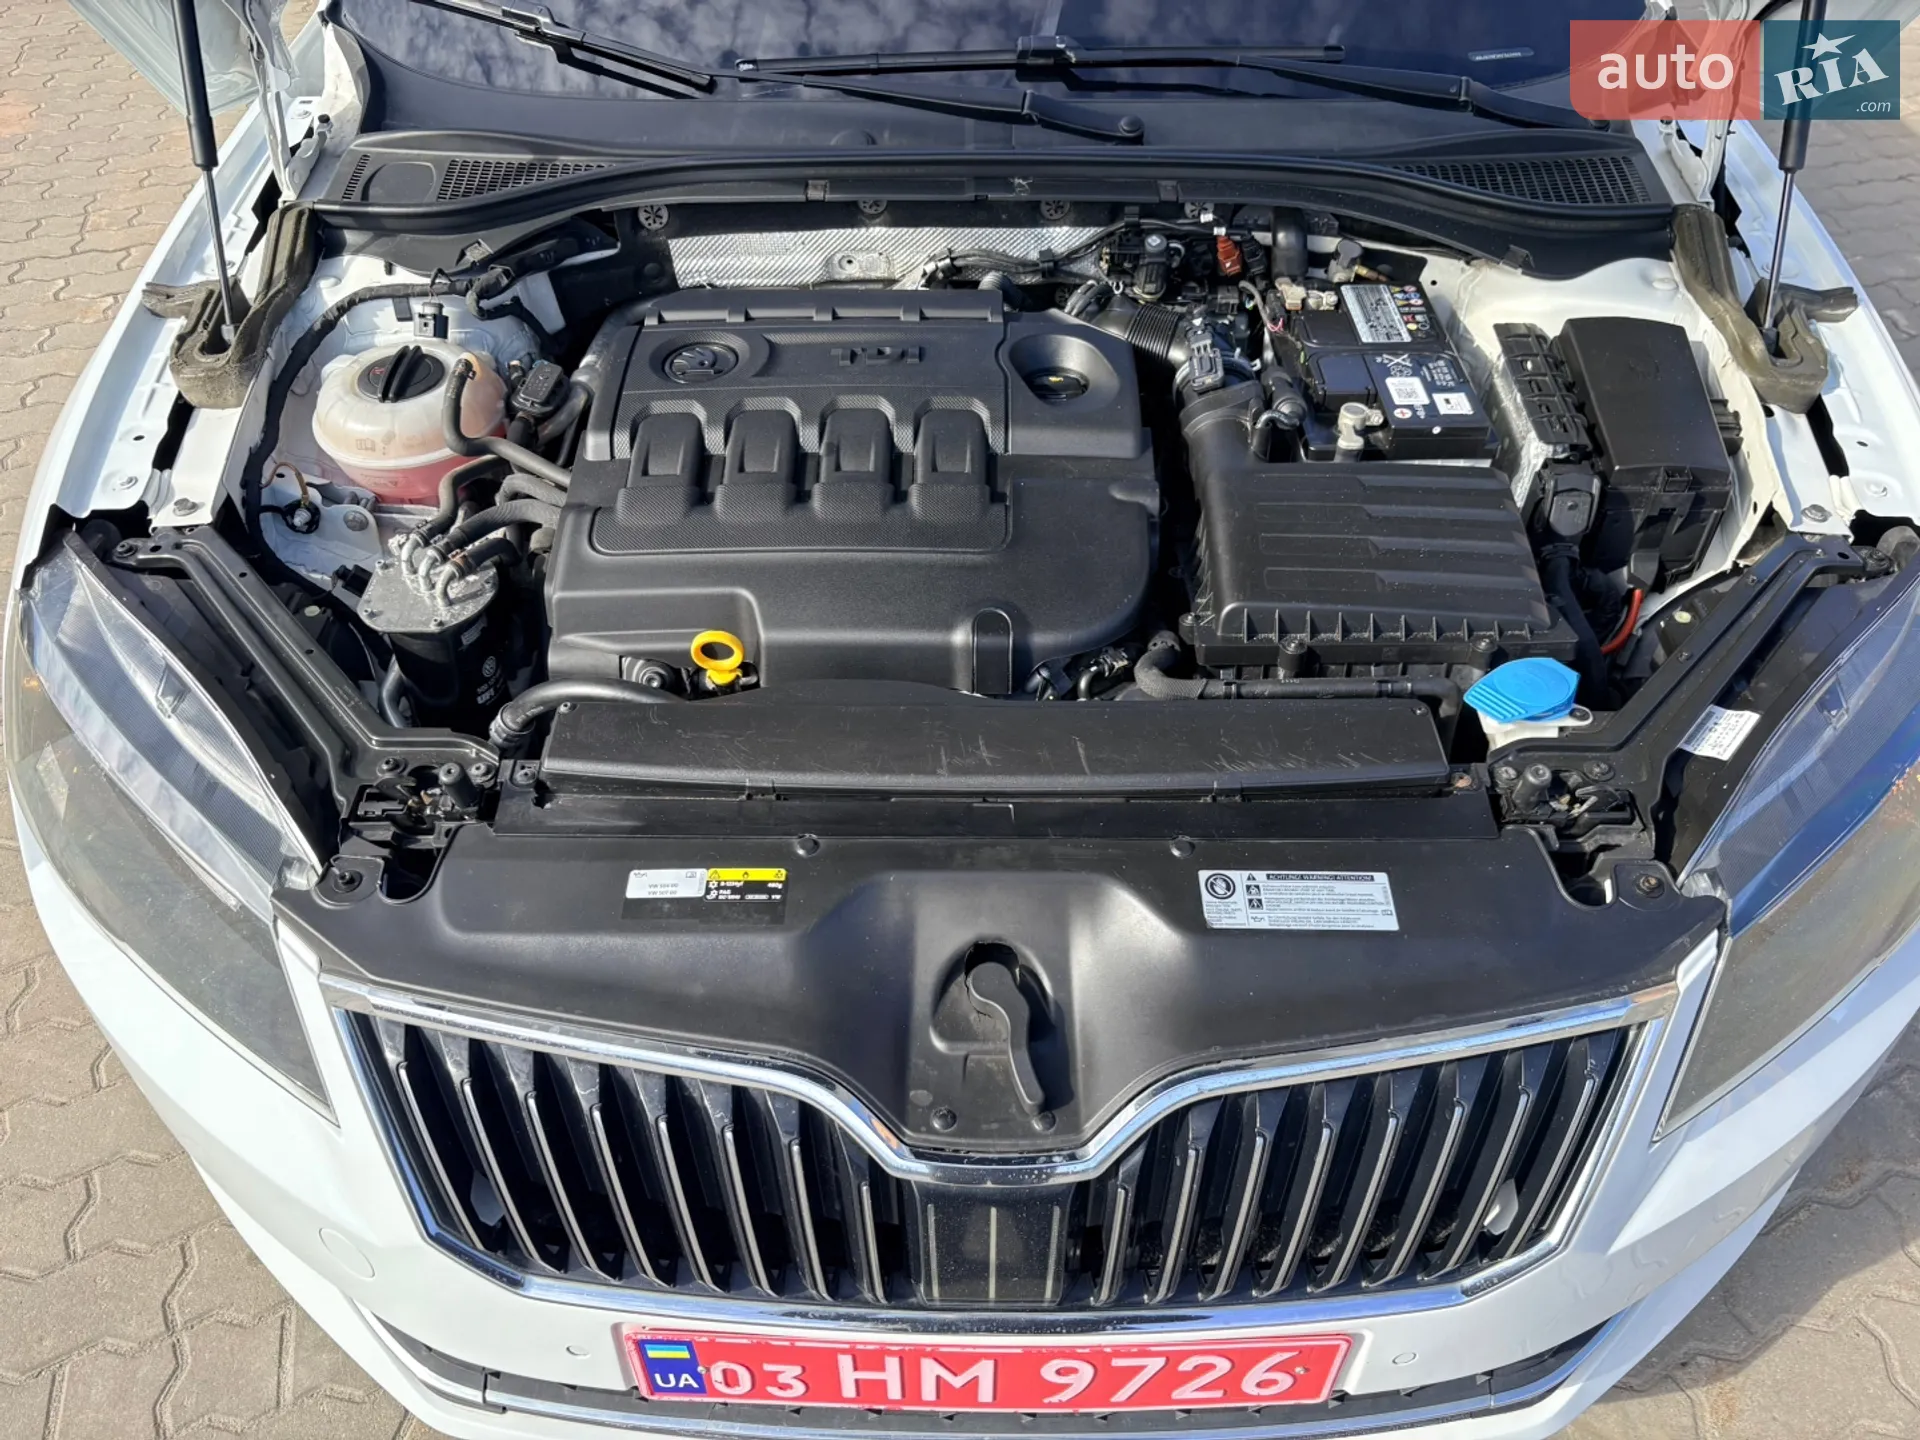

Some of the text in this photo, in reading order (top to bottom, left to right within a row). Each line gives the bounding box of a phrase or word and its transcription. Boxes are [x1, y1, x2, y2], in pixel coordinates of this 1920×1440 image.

[830, 345, 926, 367] TDI
[654, 1373, 699, 1388] UA
[710, 1351, 1301, 1402] 03 HM 9726
